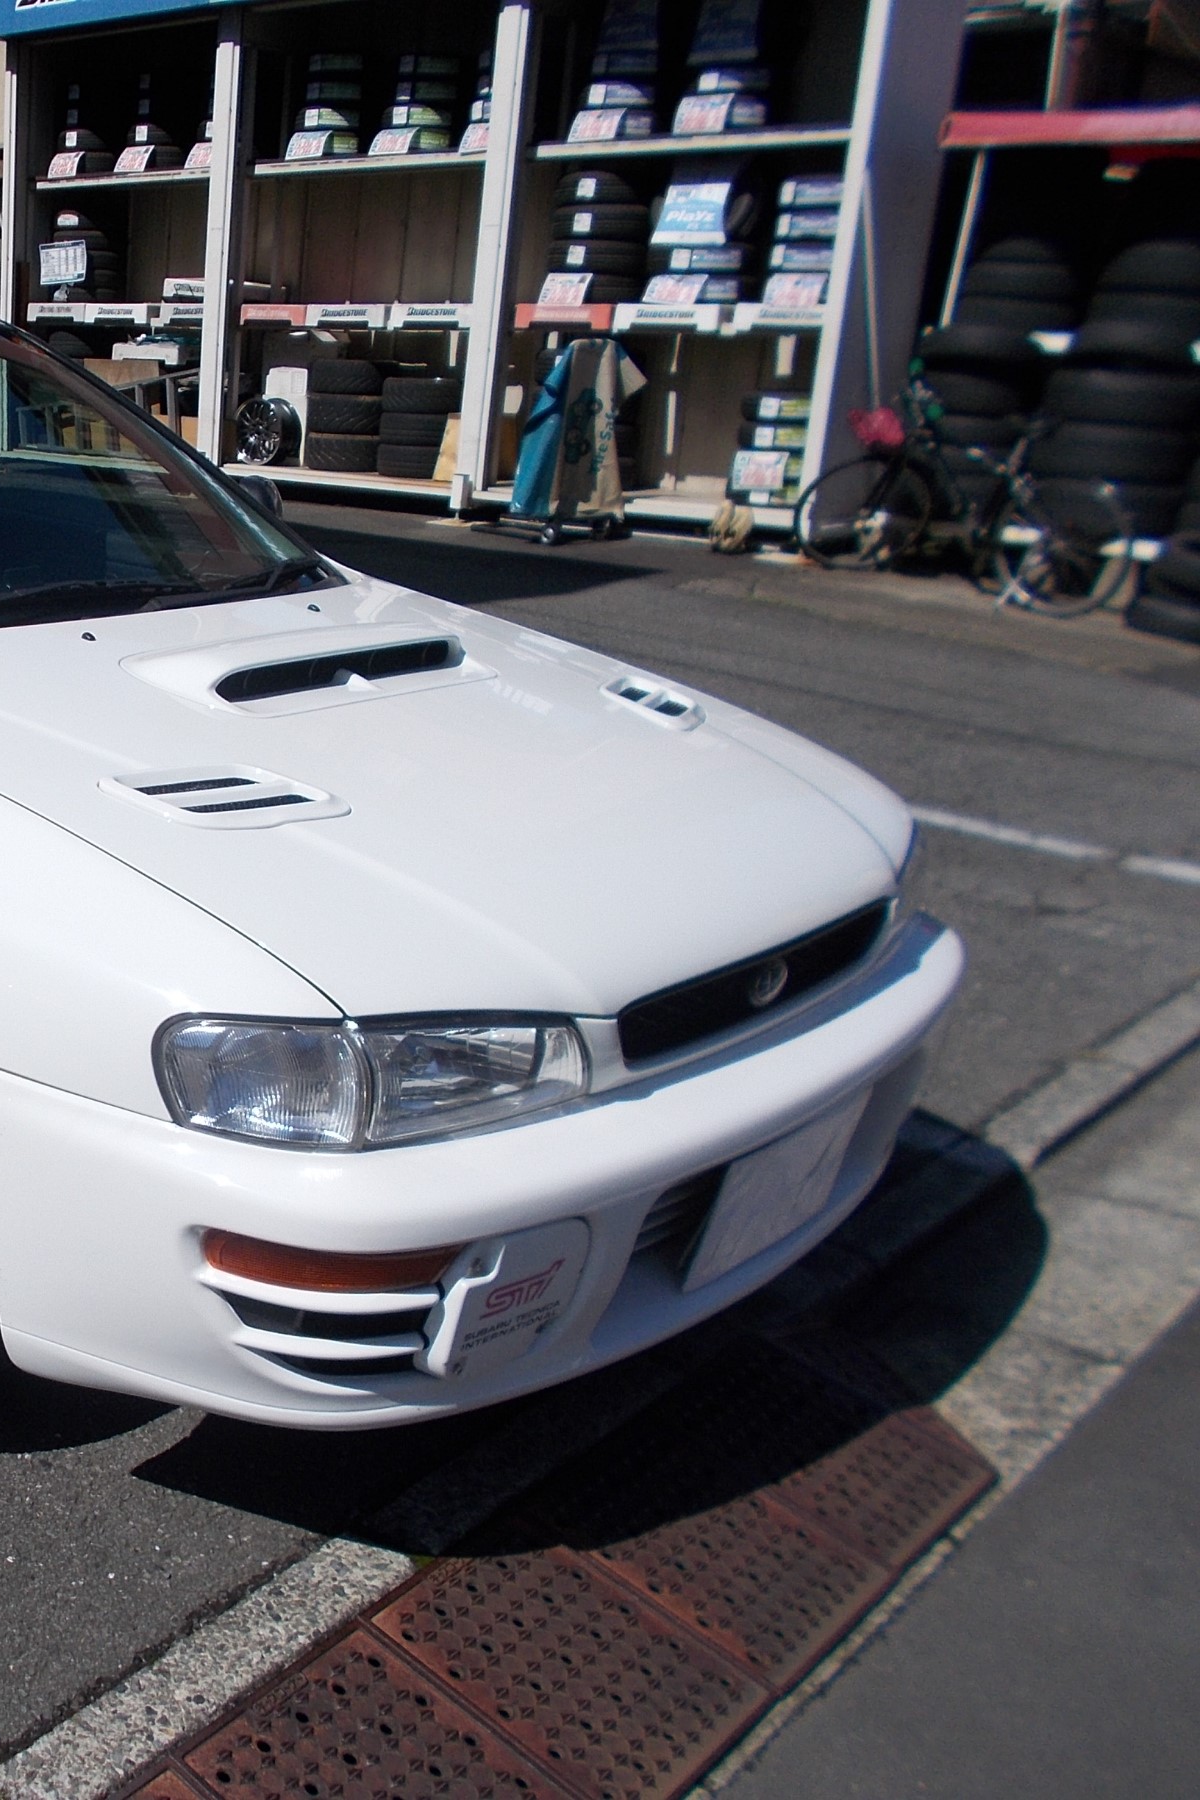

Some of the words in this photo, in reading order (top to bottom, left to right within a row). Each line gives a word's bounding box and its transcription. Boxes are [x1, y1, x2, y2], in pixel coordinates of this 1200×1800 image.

[172, 307, 203, 315] BRIDGEST
[321, 308, 368, 317] BRIDGESTONE
[406, 306, 458, 316] BRIDGESTONE
[635, 308, 696, 319] BRIDGESTONE
[464, 1319, 513, 1341] SUBARU
[517, 1300, 561, 1320] TECNICA
[461, 1310, 558, 1351] INTERNATIONAL
